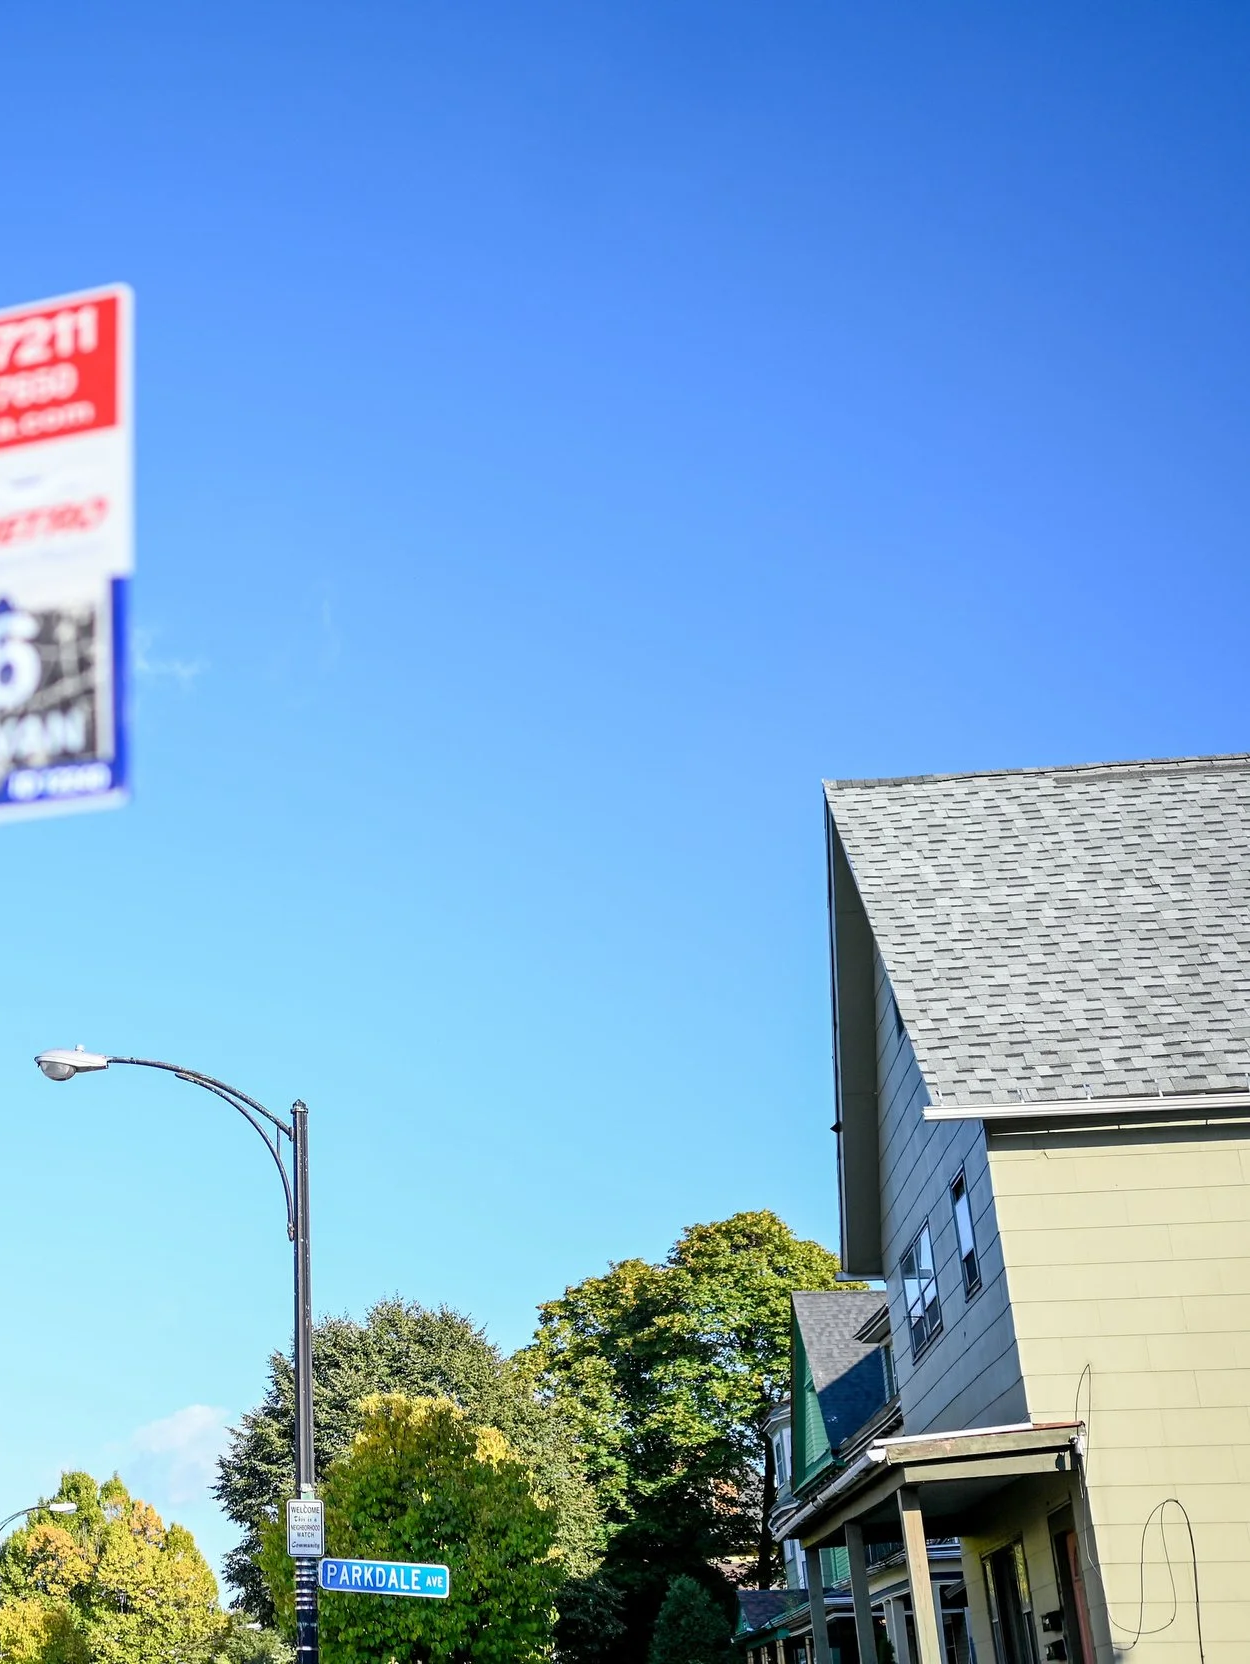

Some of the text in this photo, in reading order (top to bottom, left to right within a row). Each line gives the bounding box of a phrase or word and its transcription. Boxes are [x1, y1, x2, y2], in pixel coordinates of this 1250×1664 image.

[291, 1506, 320, 1514] WELCOME
[291, 1541, 320, 1550] Community
[327, 1563, 444, 1591] PARKDALE AVE
